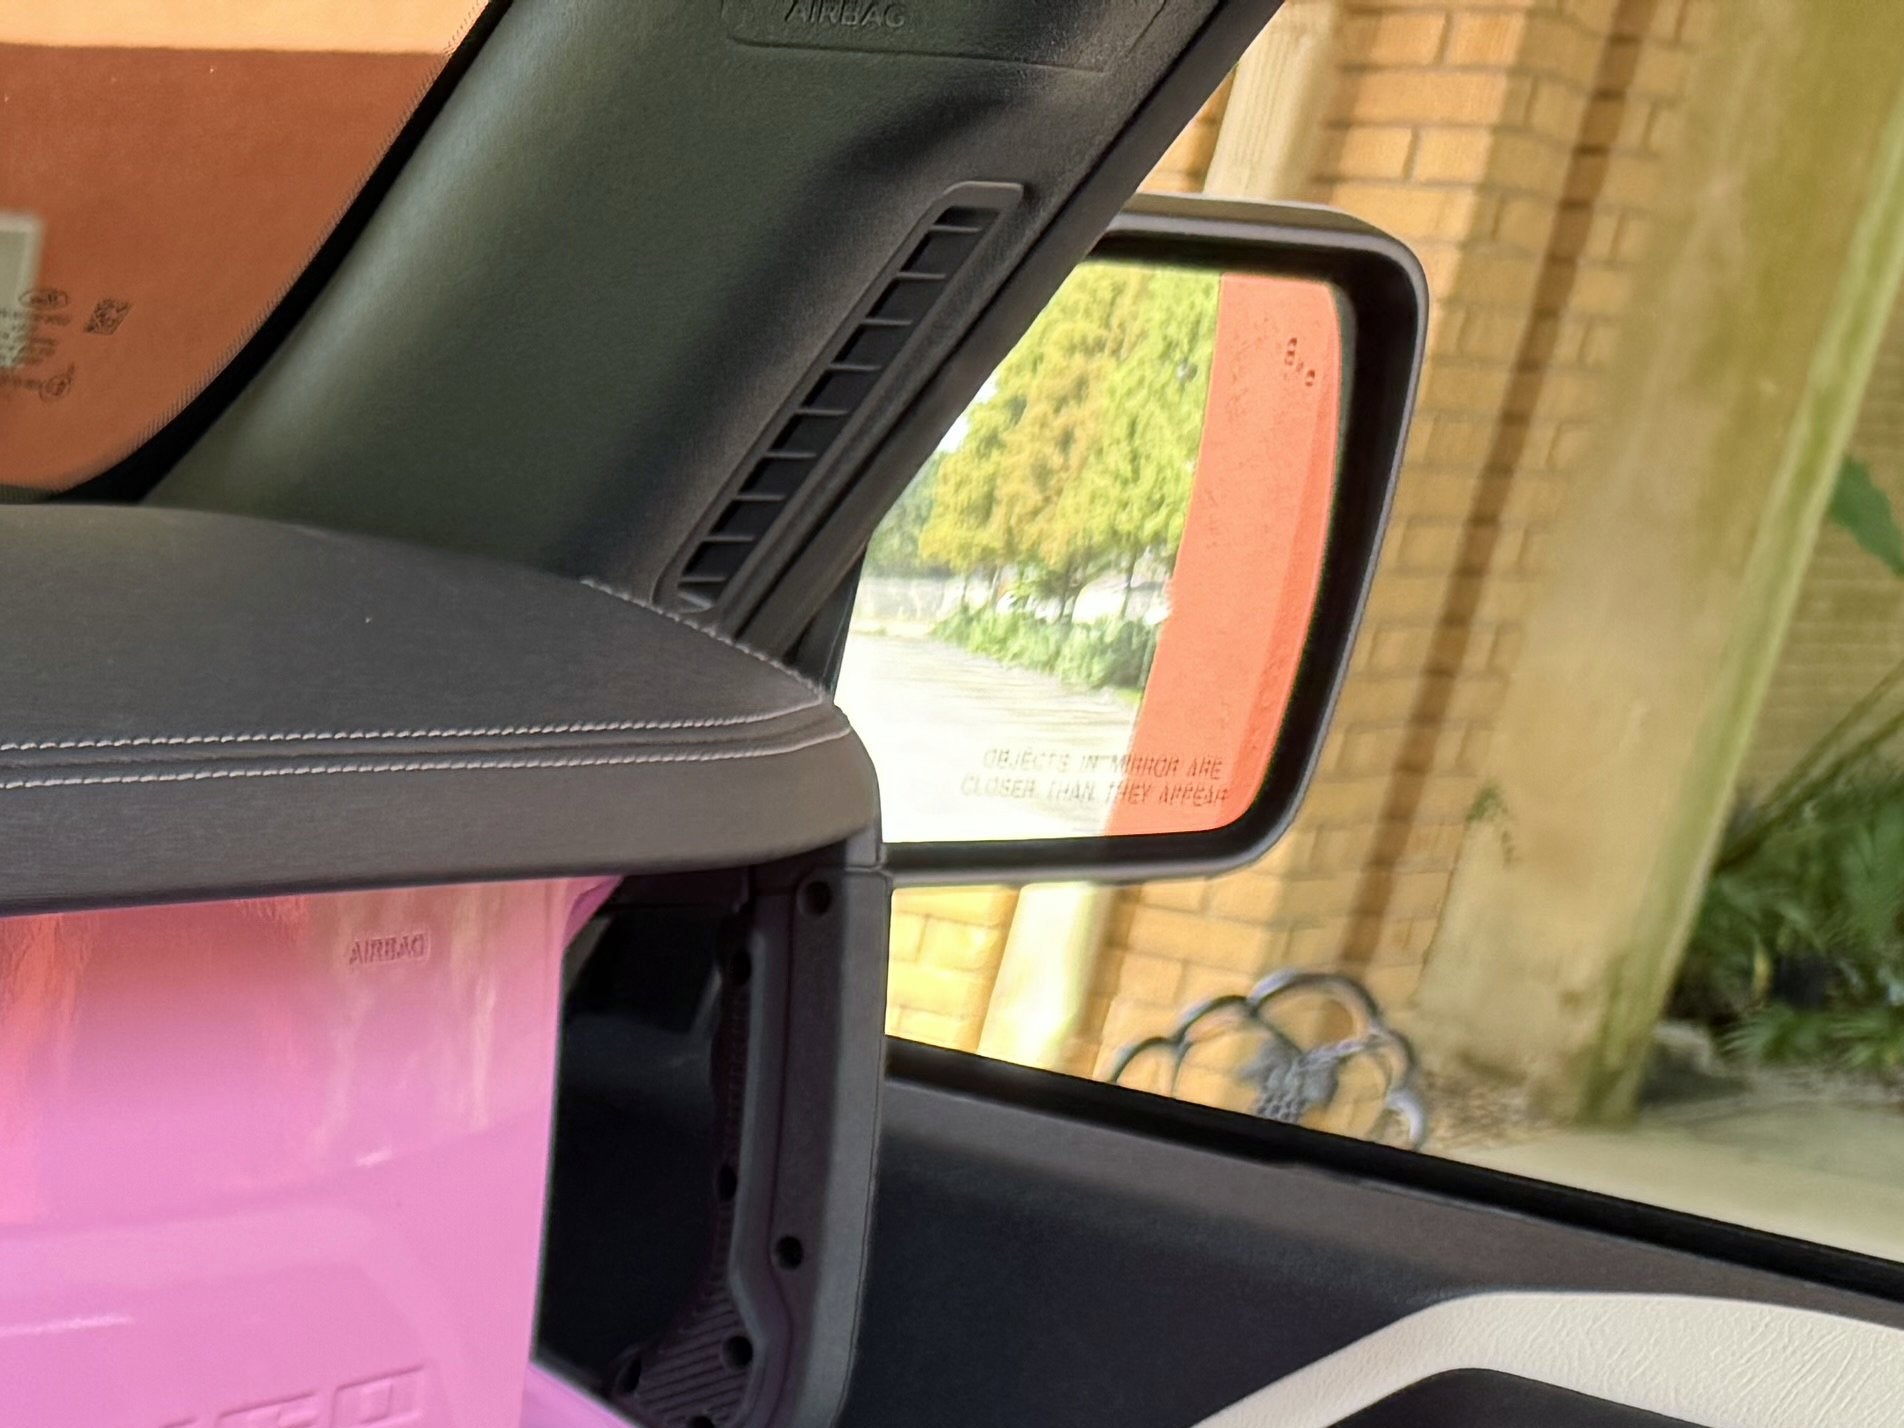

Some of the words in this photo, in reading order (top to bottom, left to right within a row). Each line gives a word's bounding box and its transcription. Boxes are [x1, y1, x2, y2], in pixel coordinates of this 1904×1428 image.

[785, 0, 905, 28] AIRBAG
[983, 749, 1070, 771] OBJECTS
[1110, 753, 1181, 777] MIRROR
[1186, 754, 1226, 780] ARE
[960, 772, 1035, 799] CLOSER
[1104, 780, 1152, 804] THEY
[1158, 784, 1228, 807] APPEAR
